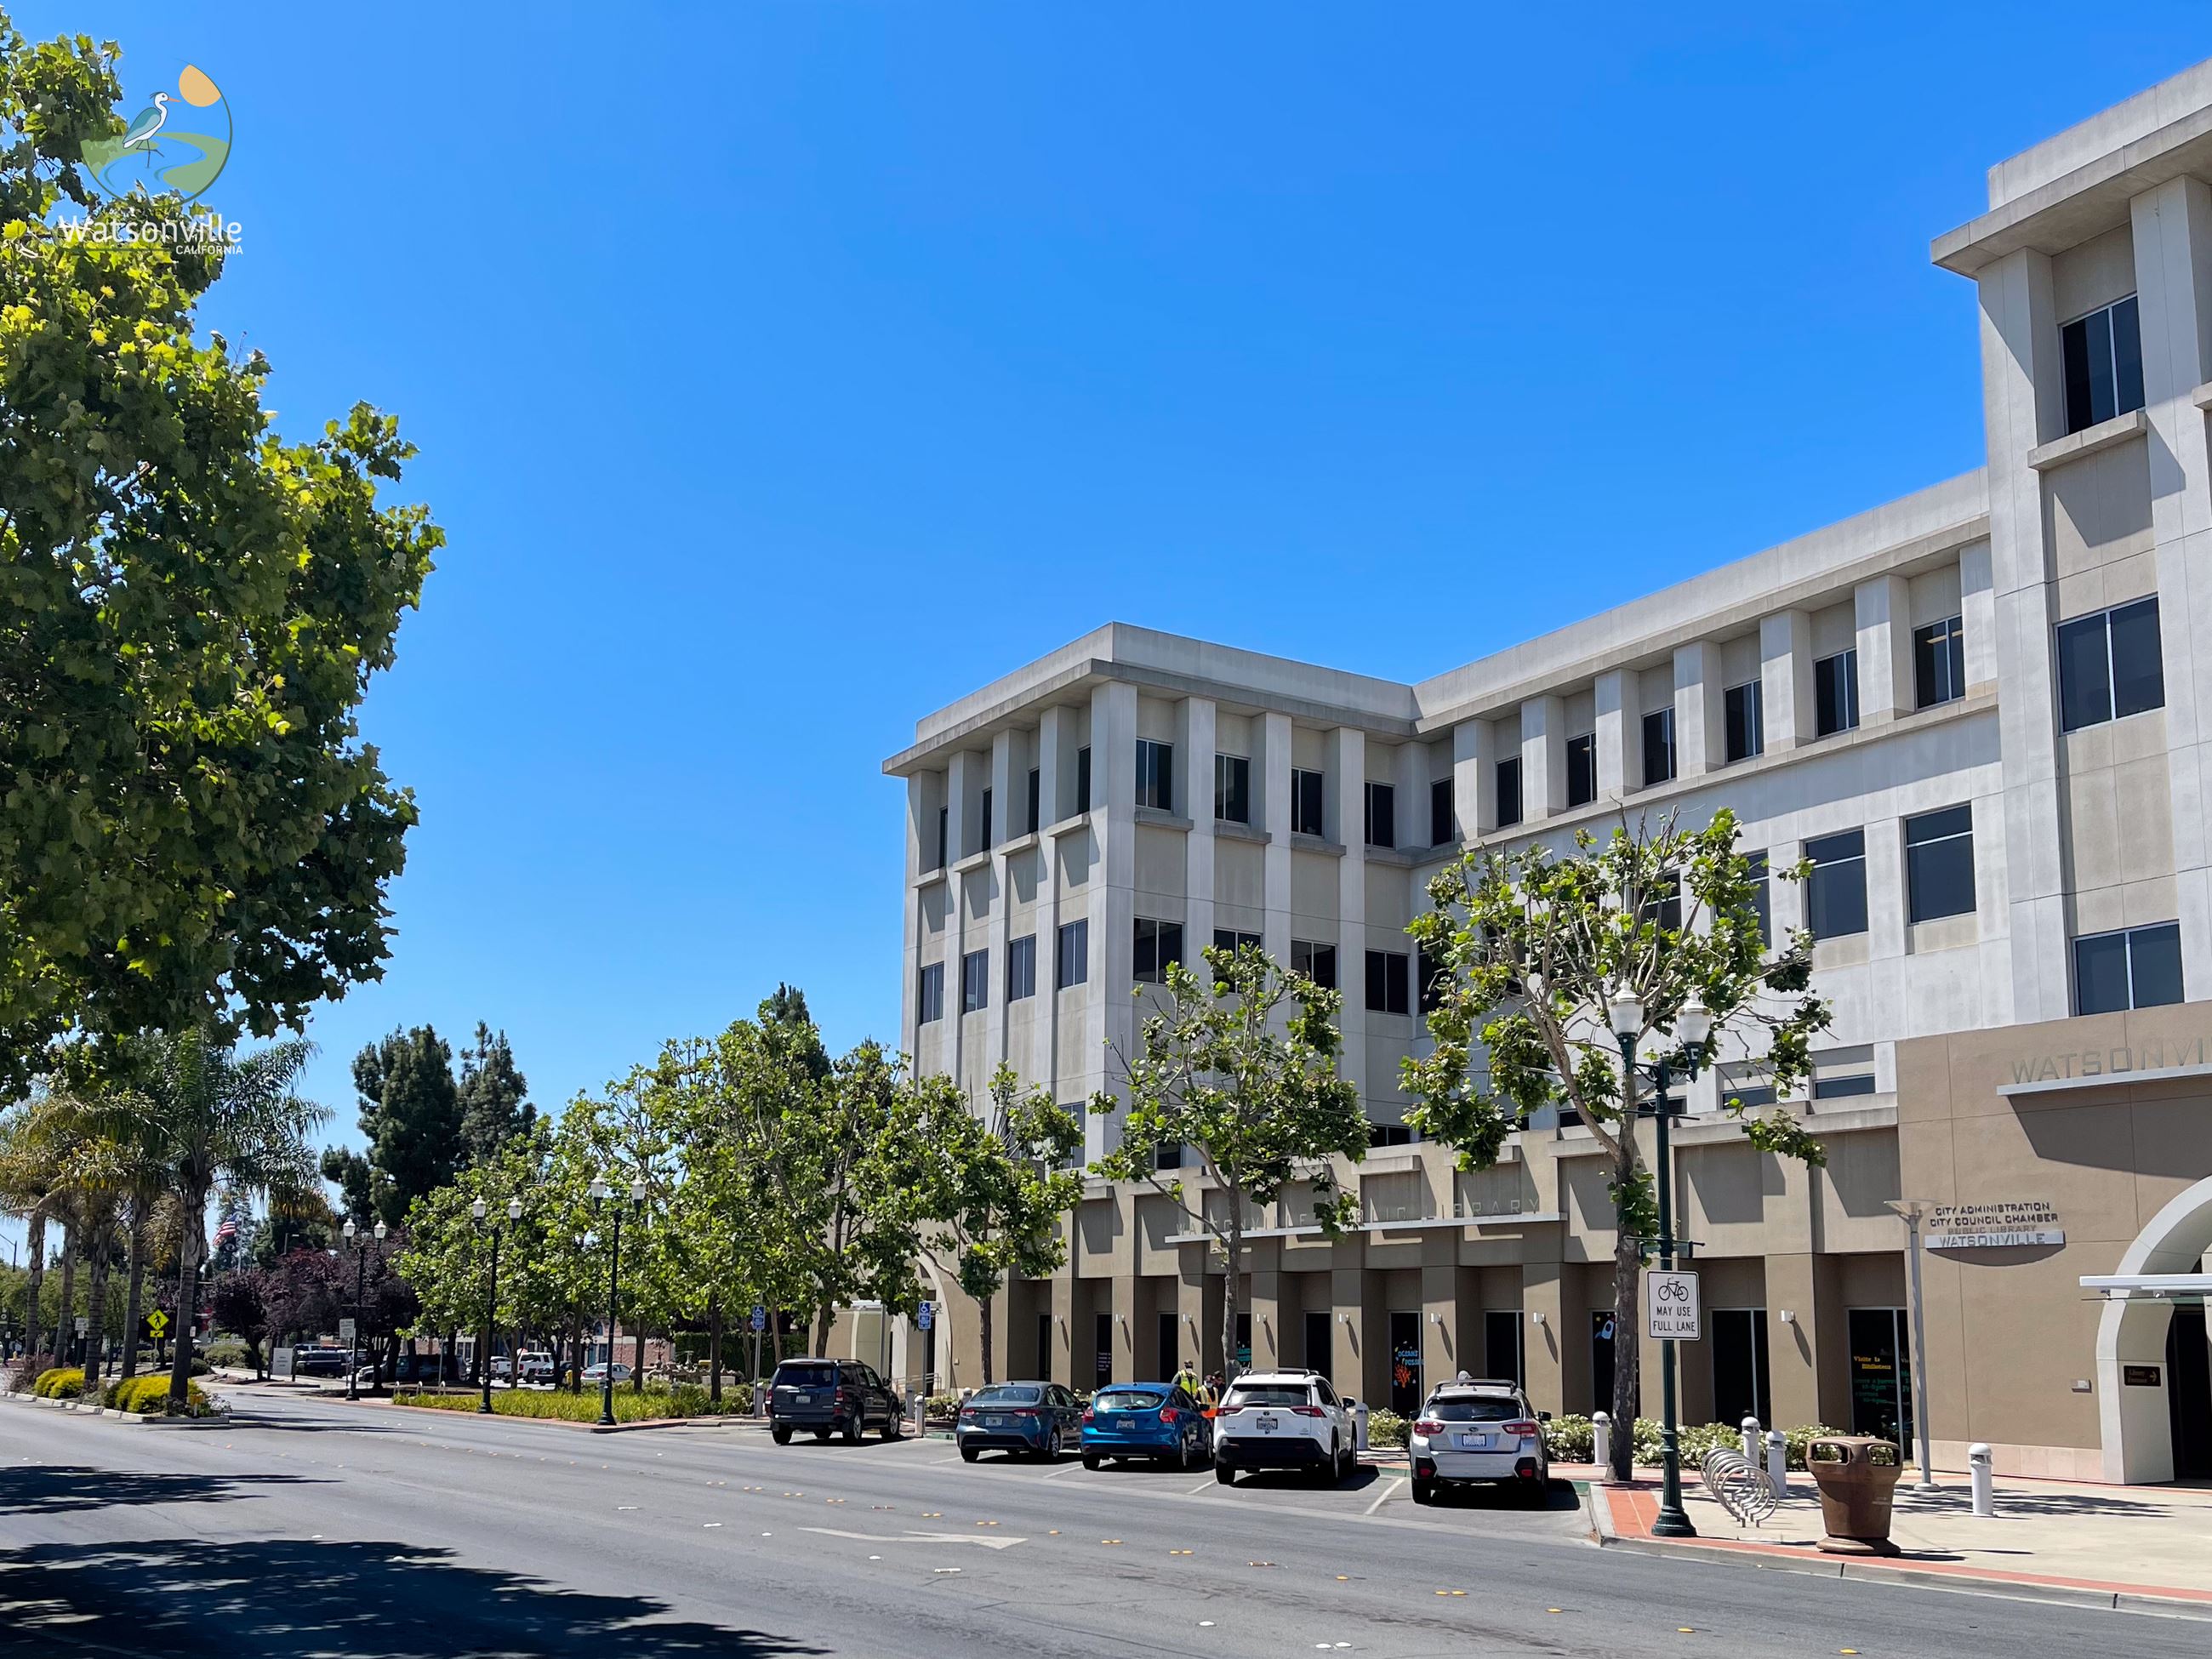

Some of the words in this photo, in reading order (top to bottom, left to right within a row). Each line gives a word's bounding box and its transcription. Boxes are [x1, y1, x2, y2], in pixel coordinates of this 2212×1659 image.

[2011, 1037, 2212, 1085] WATSONVI
[1936, 1206, 1957, 1217] CITY
[1960, 1201, 2050, 1215] ADMINISTRATION
[1930, 1217, 1952, 1227] CITY
[1955, 1216, 2002, 1227] COUNCIL
[2005, 1213, 2059, 1224] CHAMBER
[1947, 1226, 1987, 1234] PUBLIC
[1990, 1224, 2037, 1234] LIBRARY
[1939, 1233, 2046, 1247] WATSONVILLE
[1656, 1306, 1673, 1316] MAY
[1677, 1306, 1691, 1317] USE
[1653, 1320, 1673, 1331] FULL
[1676, 1321, 1696, 1332] LANE
